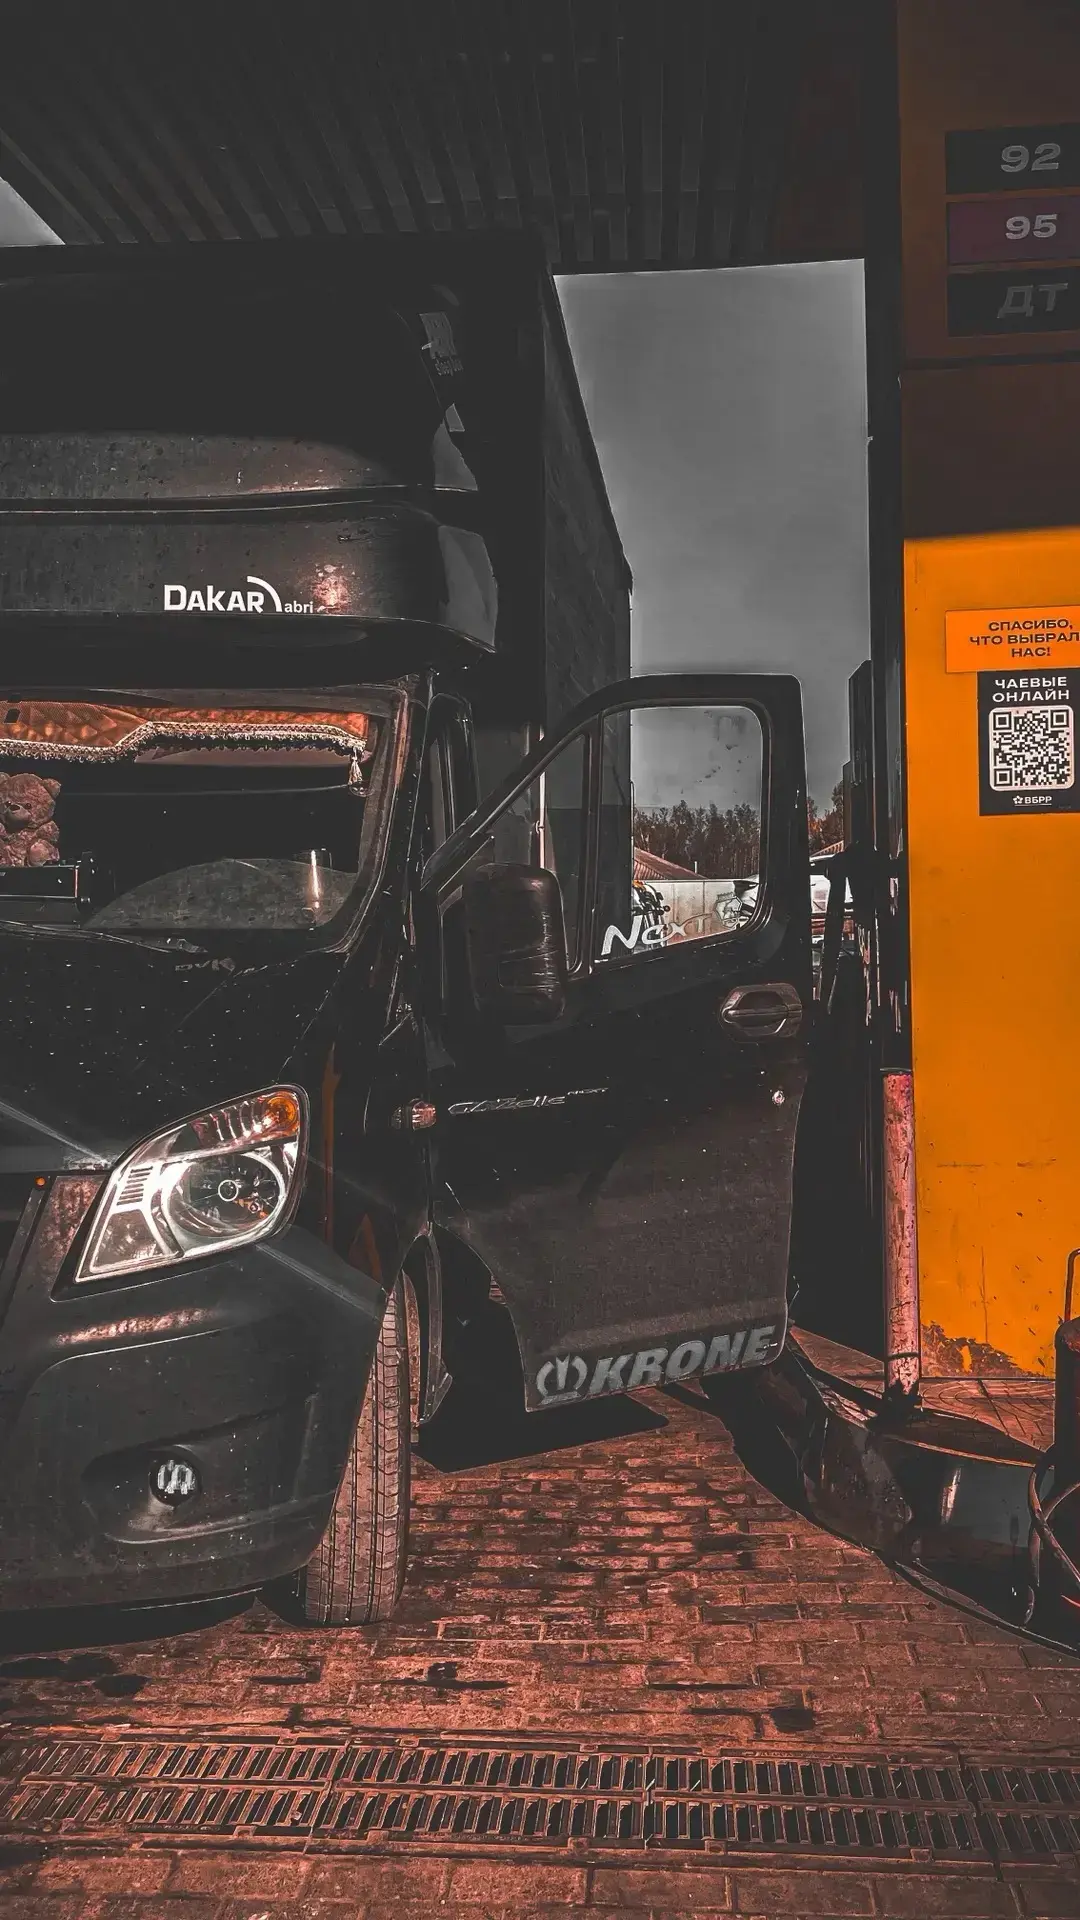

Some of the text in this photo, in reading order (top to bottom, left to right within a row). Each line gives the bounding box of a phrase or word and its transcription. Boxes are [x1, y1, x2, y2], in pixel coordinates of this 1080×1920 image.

[1000, 143, 1061, 173] 92
[1005, 213, 1058, 240] 95
[997, 282, 1069, 319] ДТ
[988, 618, 1073, 632] СПАСИБО,
[969, 635, 1003, 646] ЧТО
[1011, 646, 1051, 658] НАС!
[994, 676, 1067, 689] ЧАЕВЫЕ
[992, 688, 1070, 703] ОНЛАЙН
[1024, 795, 1052, 805] ВБРР
[587, 1325, 775, 1395] KRONE
